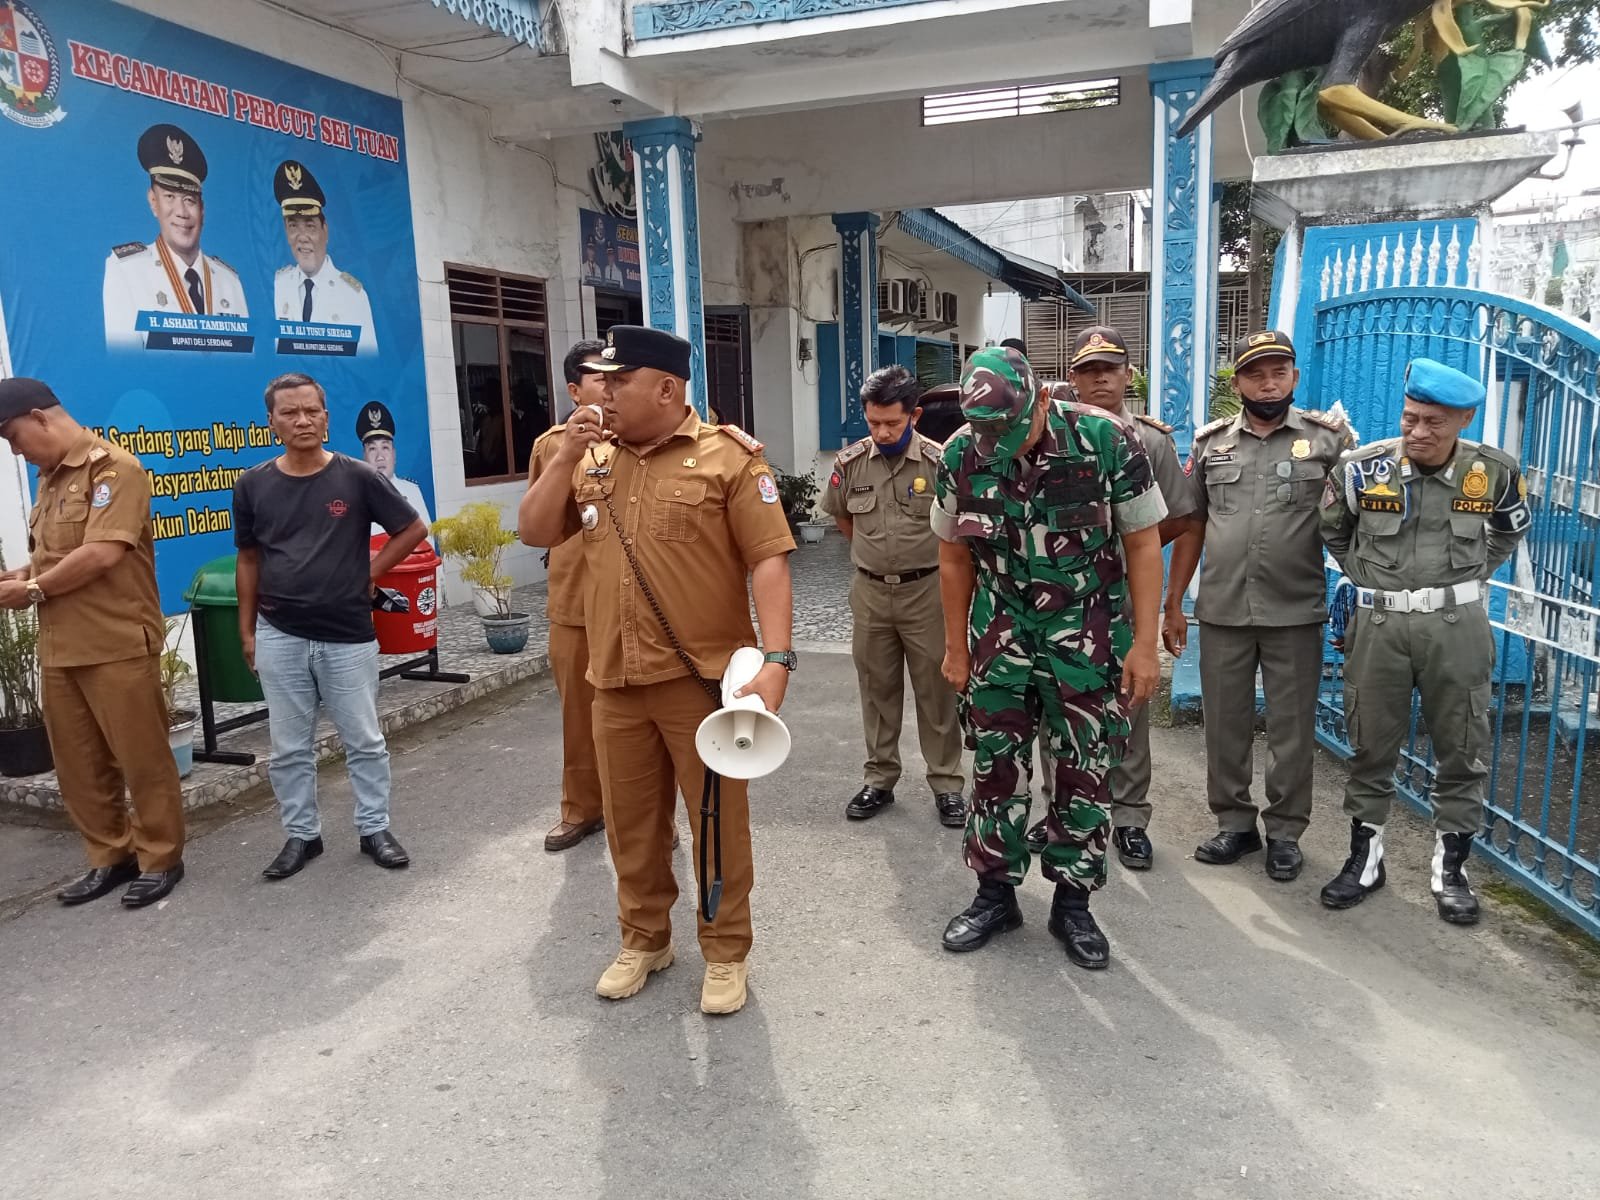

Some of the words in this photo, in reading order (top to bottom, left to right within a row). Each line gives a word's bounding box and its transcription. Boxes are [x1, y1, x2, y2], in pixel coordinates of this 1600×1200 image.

[68, 40, 229, 118] KECAMATAN
[233, 89, 315, 140] PERCUT
[320, 116, 352, 149] SEI
[355, 127, 399, 162] TUAN
[149, 317, 160, 327] H.
[163, 317, 198, 330] ASHARI
[200, 319, 248, 332] TAMBUNAN
[295, 326, 306, 335] ALI
[306, 326, 326, 336] YUSUF
[327, 328, 352, 338] SIREGAR
[172, 337, 193, 345] BUPATI
[194, 338, 206, 346] DELI
[207, 339, 232, 347] SERDANG
[109, 425, 174, 457] Serdang
[176, 428, 210, 457] yang
[212, 422, 244, 450] Maju
[248, 422, 272, 448] dan
[1362, 499, 1401, 511] WIRA
[1454, 500, 1493, 513] POL-PP
[186, 506, 232, 535] Dalam
[1508, 509, 1525, 530] P
